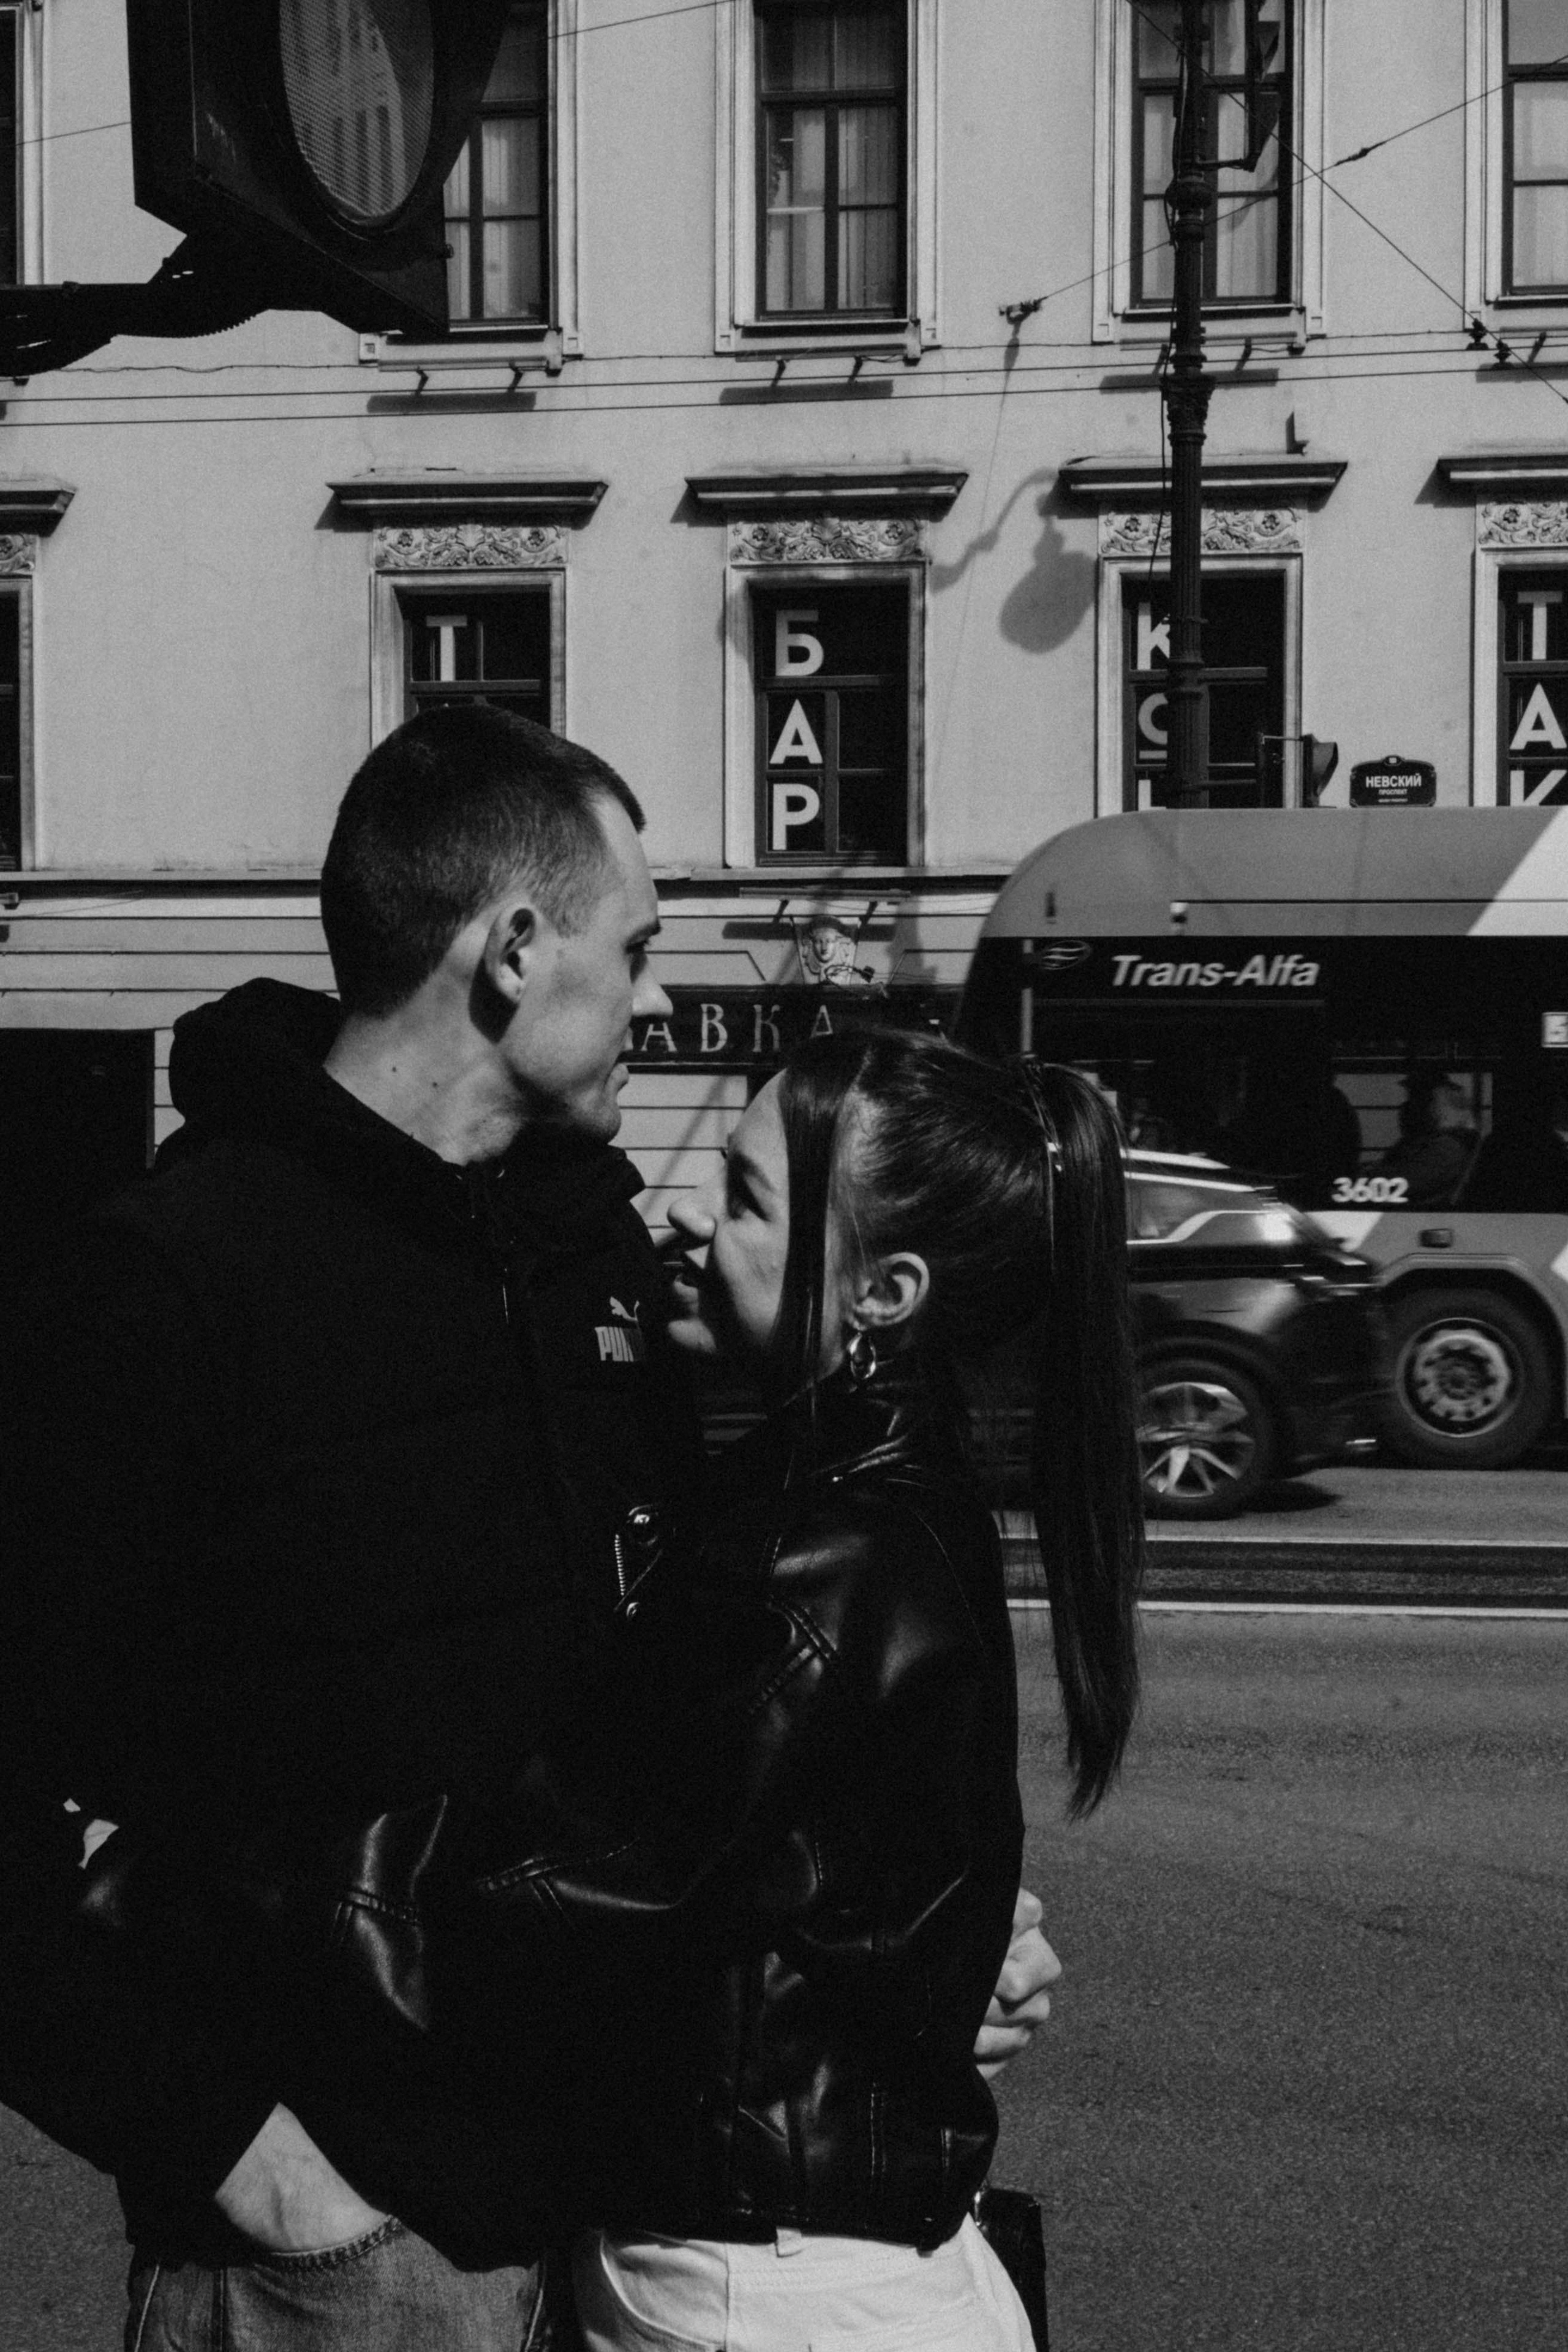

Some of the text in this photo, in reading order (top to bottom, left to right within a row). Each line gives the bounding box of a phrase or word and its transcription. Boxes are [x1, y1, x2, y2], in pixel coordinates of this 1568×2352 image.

[769, 610, 824, 851] БАР
[1365, 772, 1422, 788] НЕВСКИЙ
[1111, 954, 1321, 987] Trans-Alfa
[639, 1003, 834, 1052] АВКА
[1330, 1177, 1409, 1204] 3602
